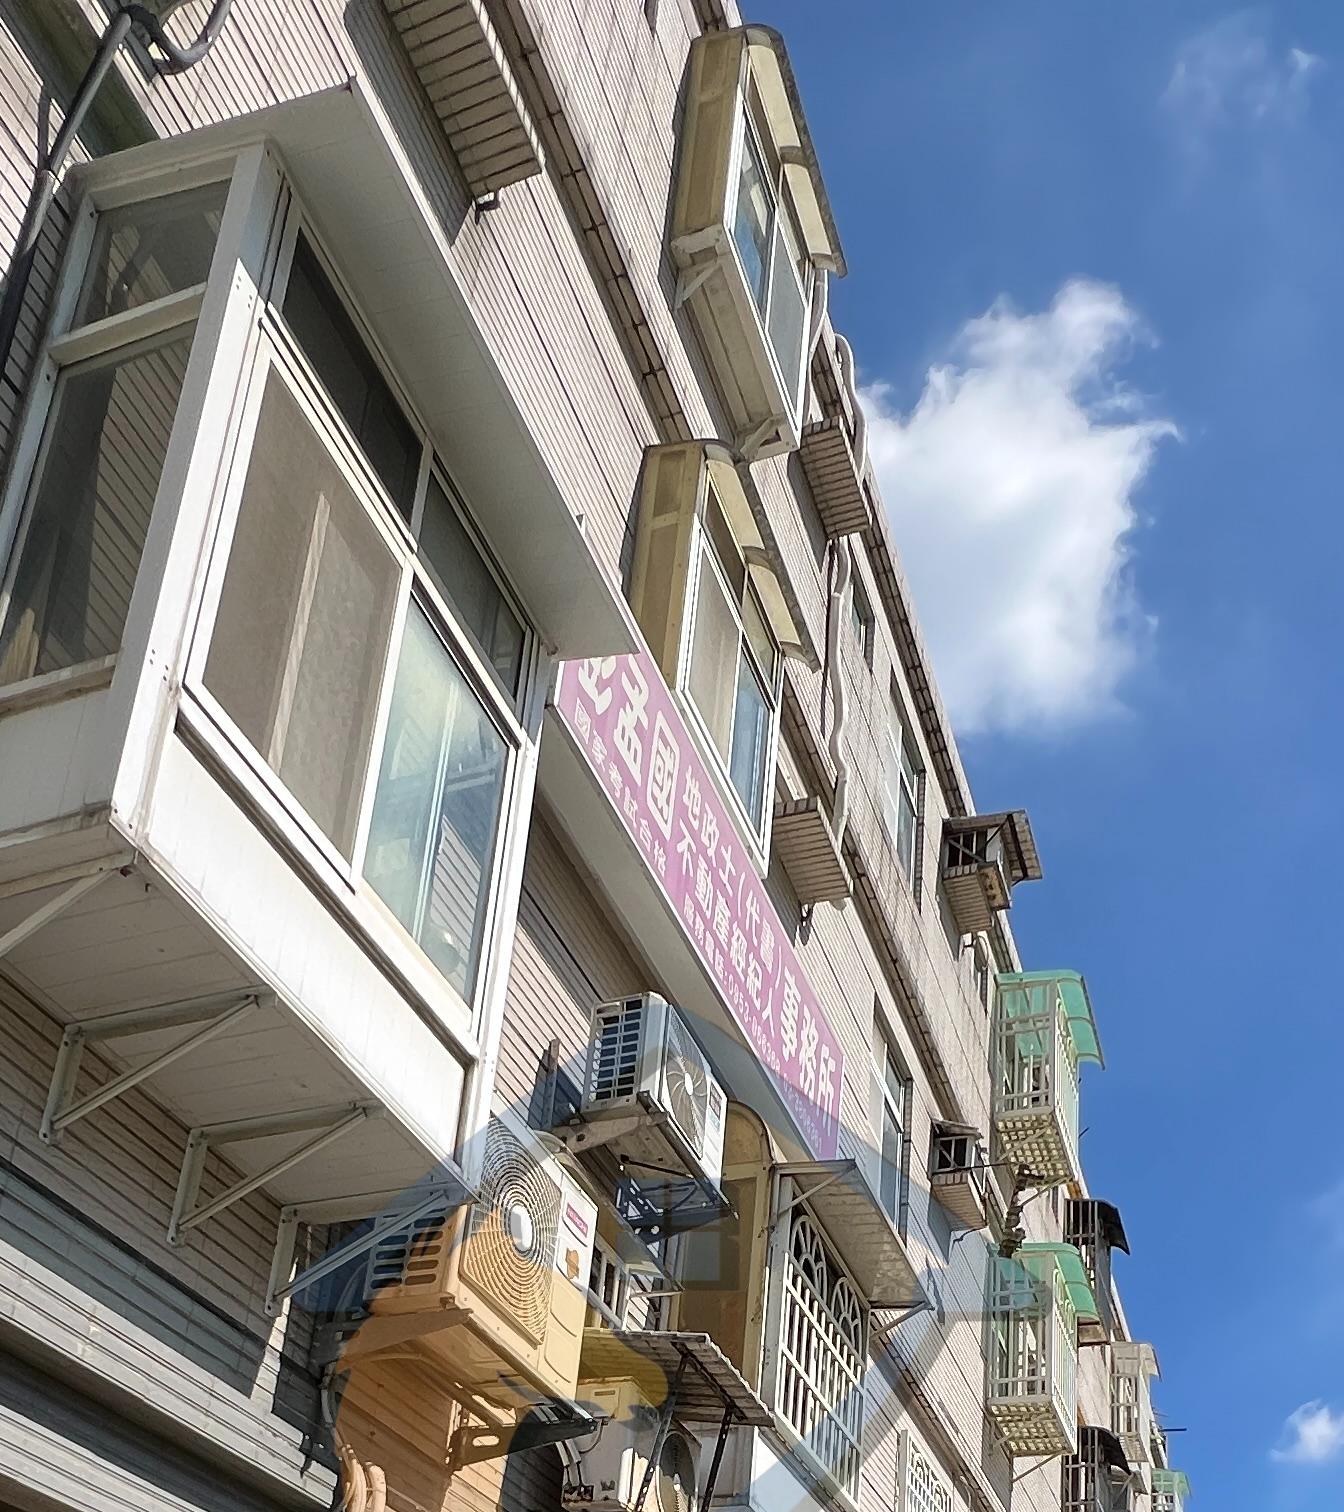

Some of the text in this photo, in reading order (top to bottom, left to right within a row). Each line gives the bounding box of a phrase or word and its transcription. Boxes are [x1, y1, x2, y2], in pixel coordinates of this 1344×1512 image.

[677, 820, 775, 1036] 不動產經紀人
[684, 765, 782, 990] 地政士(代書)
[780, 966, 836, 1136] 事務所
